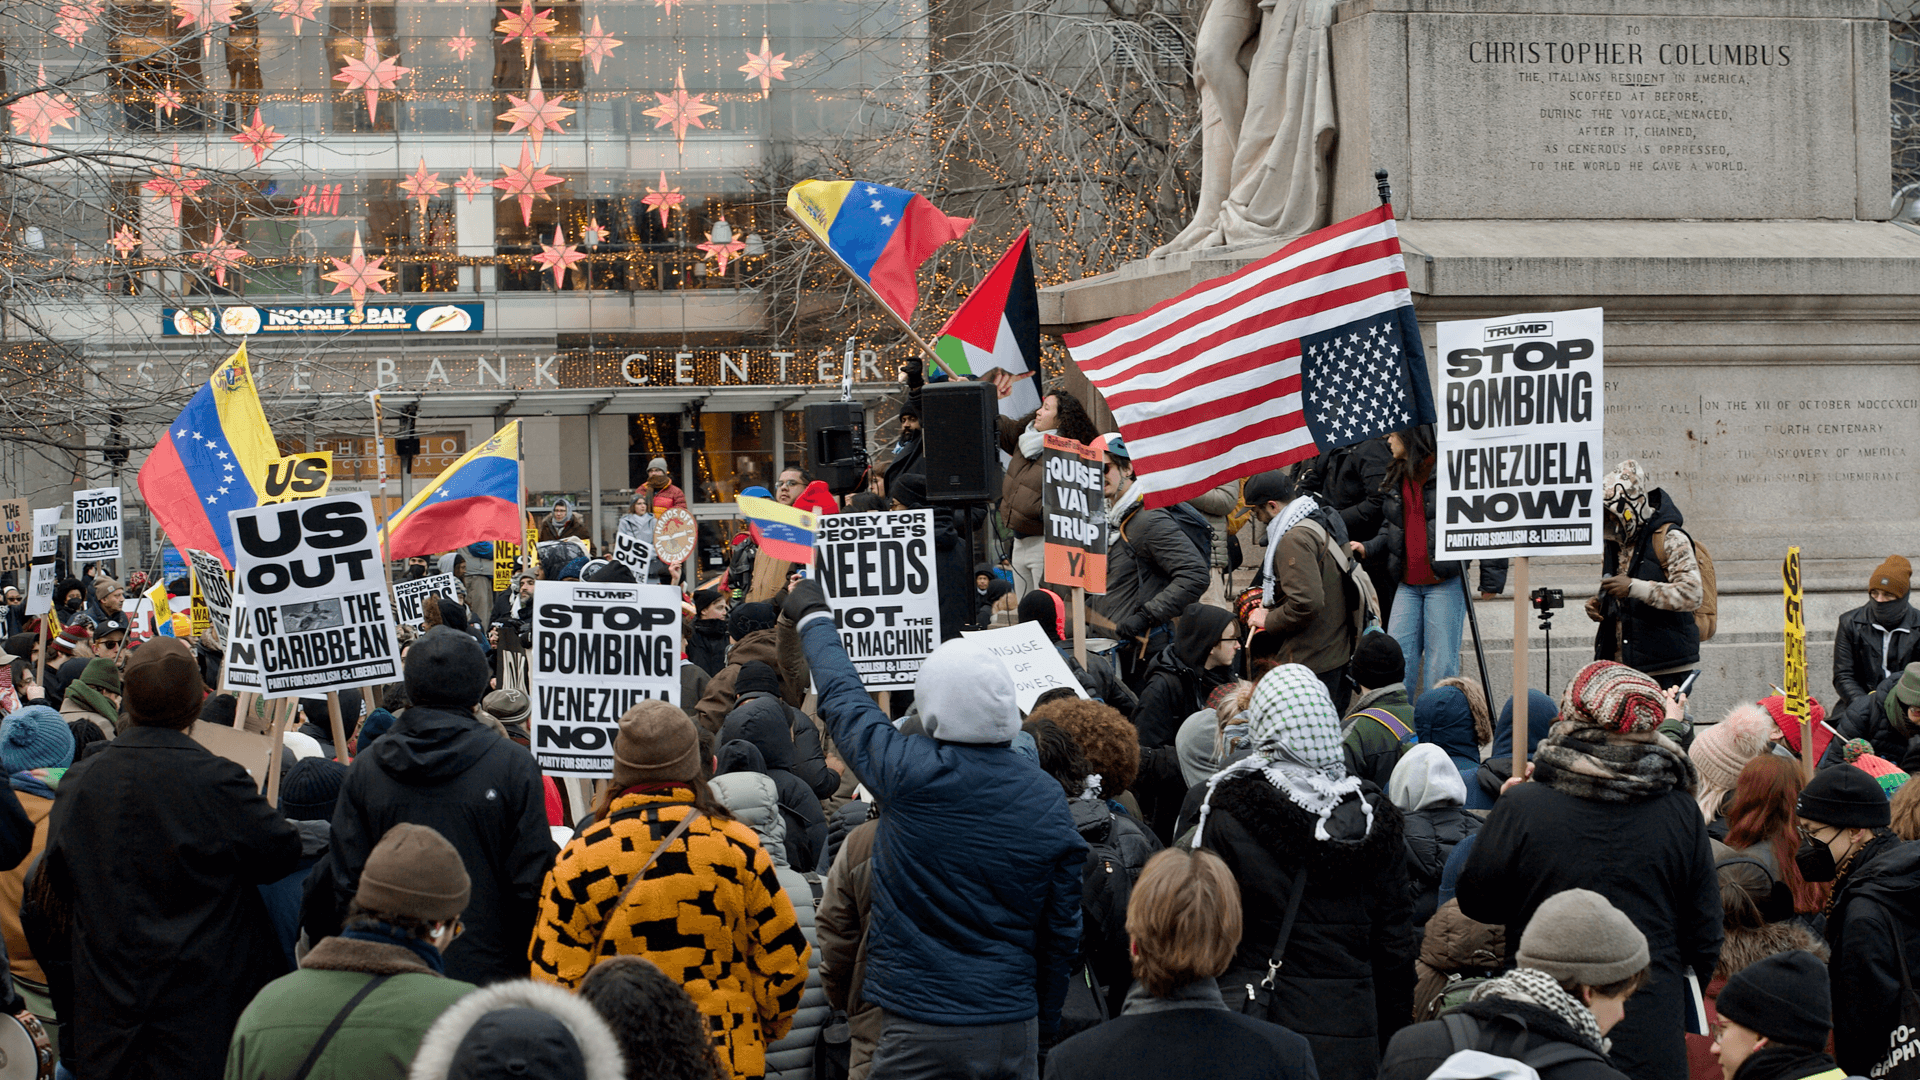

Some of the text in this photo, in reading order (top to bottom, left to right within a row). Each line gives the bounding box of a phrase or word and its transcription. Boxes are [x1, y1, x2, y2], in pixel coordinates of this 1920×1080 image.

[1626, 26, 1640, 36] TO
[1469, 41, 1791, 66] CHRISTOPHER COLUMBUS
[1549, 72, 1601, 83] ITALIANS
[1611, 73, 1665, 84] RESIDENT
[1674, 73, 1686, 83] IN
[1570, 91, 1703, 104] SCOFFED AT BEFORE,
[1540, 108, 1582, 120] DURING
[1591, 109, 1613, 120] THE
[1578, 127, 1615, 138] AFTER
[1545, 145, 1559, 155] AS
[1530, 161, 1545, 172] TO
[1554, 161, 1576, 172] THE
[1583, 161, 1621, 172] WORLD
[1629, 161, 1644, 172] HE
[1690, 162, 1698, 172] A
[293, 183, 342, 216] H&M
[269, 308, 406, 325] NOODLE BAR
[1487, 324, 1547, 338] TRUMP
[1446, 338, 1594, 378] STOP
[376, 358, 560, 389] BANK
[621, 349, 884, 385] CENTER
[1447, 371, 1592, 432] BOMBING
[1704, 401, 1719, 410] ON
[1727, 400, 1747, 410] THE
[1777, 400, 1791, 410] OF
[1798, 400, 1851, 410] OCTOBER
[1817, 424, 1884, 434] CENTENARY
[315, 440, 375, 455] THE
[1447, 441, 1593, 491] VENEZUELA
[265, 457, 328, 497] US
[77, 496, 117, 508] STOP
[1446, 489, 1593, 524] NOW!
[2, 503, 20, 519] THE
[76, 506, 118, 524] BOMBING
[886, 513, 926, 525] FOR
[7, 520, 20, 532] US
[236, 501, 368, 559] US
[655, 509, 678, 534] HANDS
[0, 532, 30, 544] EMPIRE
[76, 526, 118, 541] VENEZUELA
[818, 524, 927, 542] PEOPLE'S
[1446, 527, 1590, 548] PARTY FOR SOCIALISM & LIBERATION
[7, 543, 29, 555] MUST
[76, 540, 118, 551] NOW!
[618, 535, 648, 558] US
[1, 553, 32, 570] FALL
[616, 550, 647, 569] OUT
[247, 549, 373, 595] OUT
[815, 539, 930, 598] NEEDS
[395, 574, 450, 591] MONEY FOR
[396, 580, 451, 597] PEOPLE'S
[576, 590, 634, 600] TRUMP
[193, 609, 208, 620] WA
[254, 605, 278, 637] OF
[344, 592, 384, 625] THE
[539, 604, 676, 631] STOP
[904, 617, 933, 626] THE
[260, 623, 391, 672] CARIBBEAN
[858, 628, 934, 657] MACHINE
[988, 640, 1043, 657] MISUSE
[539, 631, 673, 677] BOMBING
[886, 661, 897, 672] &
[1014, 662, 1032, 673] OF
[229, 670, 246, 682] PARTY
[267, 674, 291, 690] PARTY
[290, 673, 304, 687] FOR
[303, 669, 341, 686] SOCIALISM
[341, 668, 351, 680] &
[351, 662, 393, 679] LIBERATION
[1016, 674, 1063, 692] OWER
[538, 685, 670, 723] VENEZU
[537, 724, 618, 750] NO
[538, 756, 561, 768] PARTY
[560, 757, 576, 769] FOR
